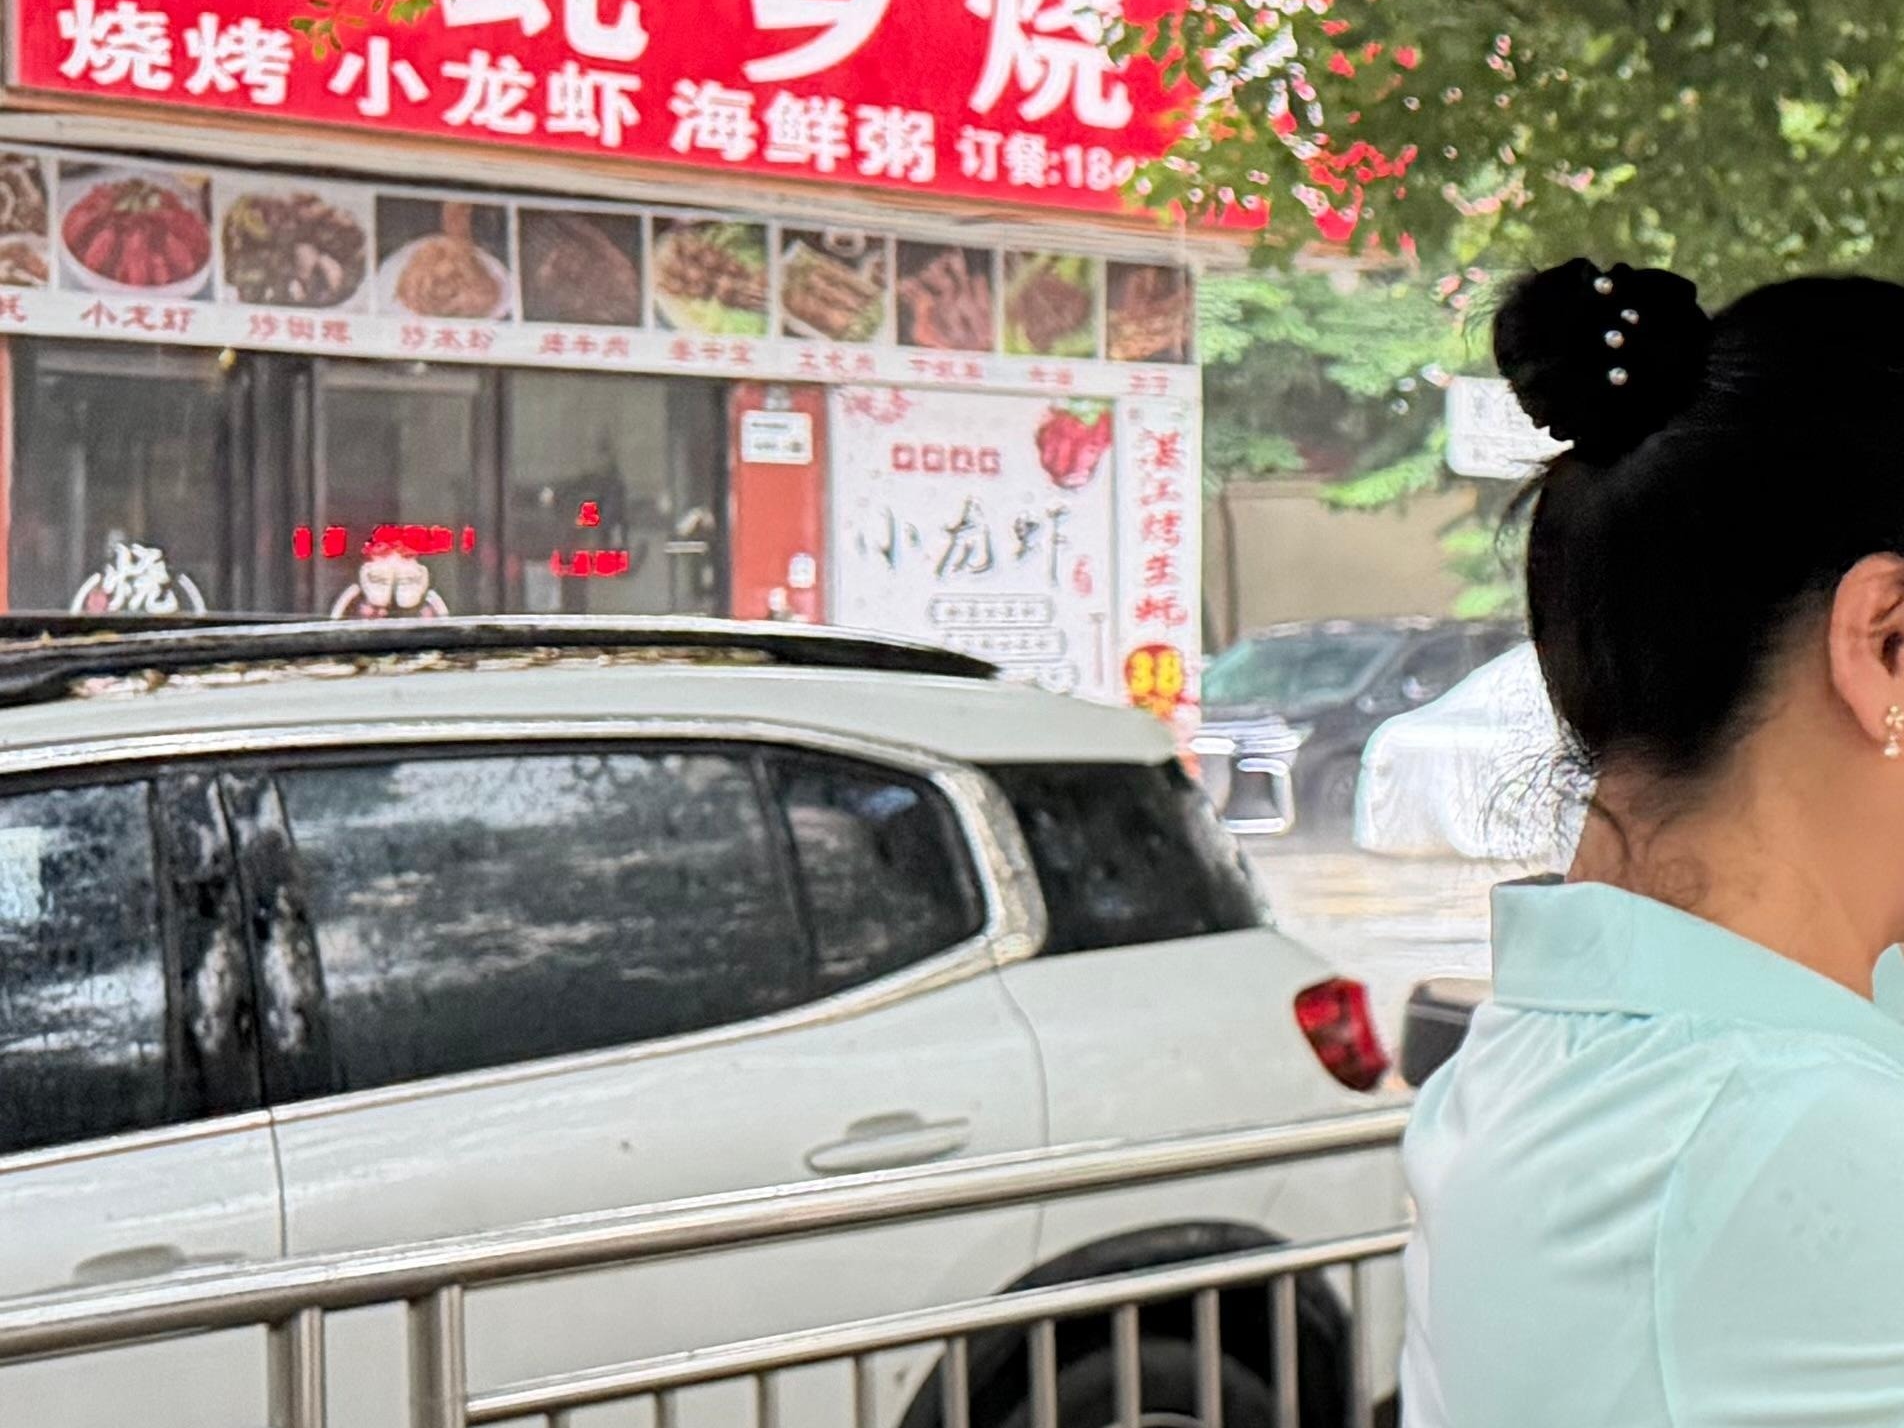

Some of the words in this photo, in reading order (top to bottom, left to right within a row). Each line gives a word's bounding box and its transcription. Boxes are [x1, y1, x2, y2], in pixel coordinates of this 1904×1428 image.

[328, 35, 643, 149] 小龙虾
[667, 79, 936, 184] 海鲜粥
